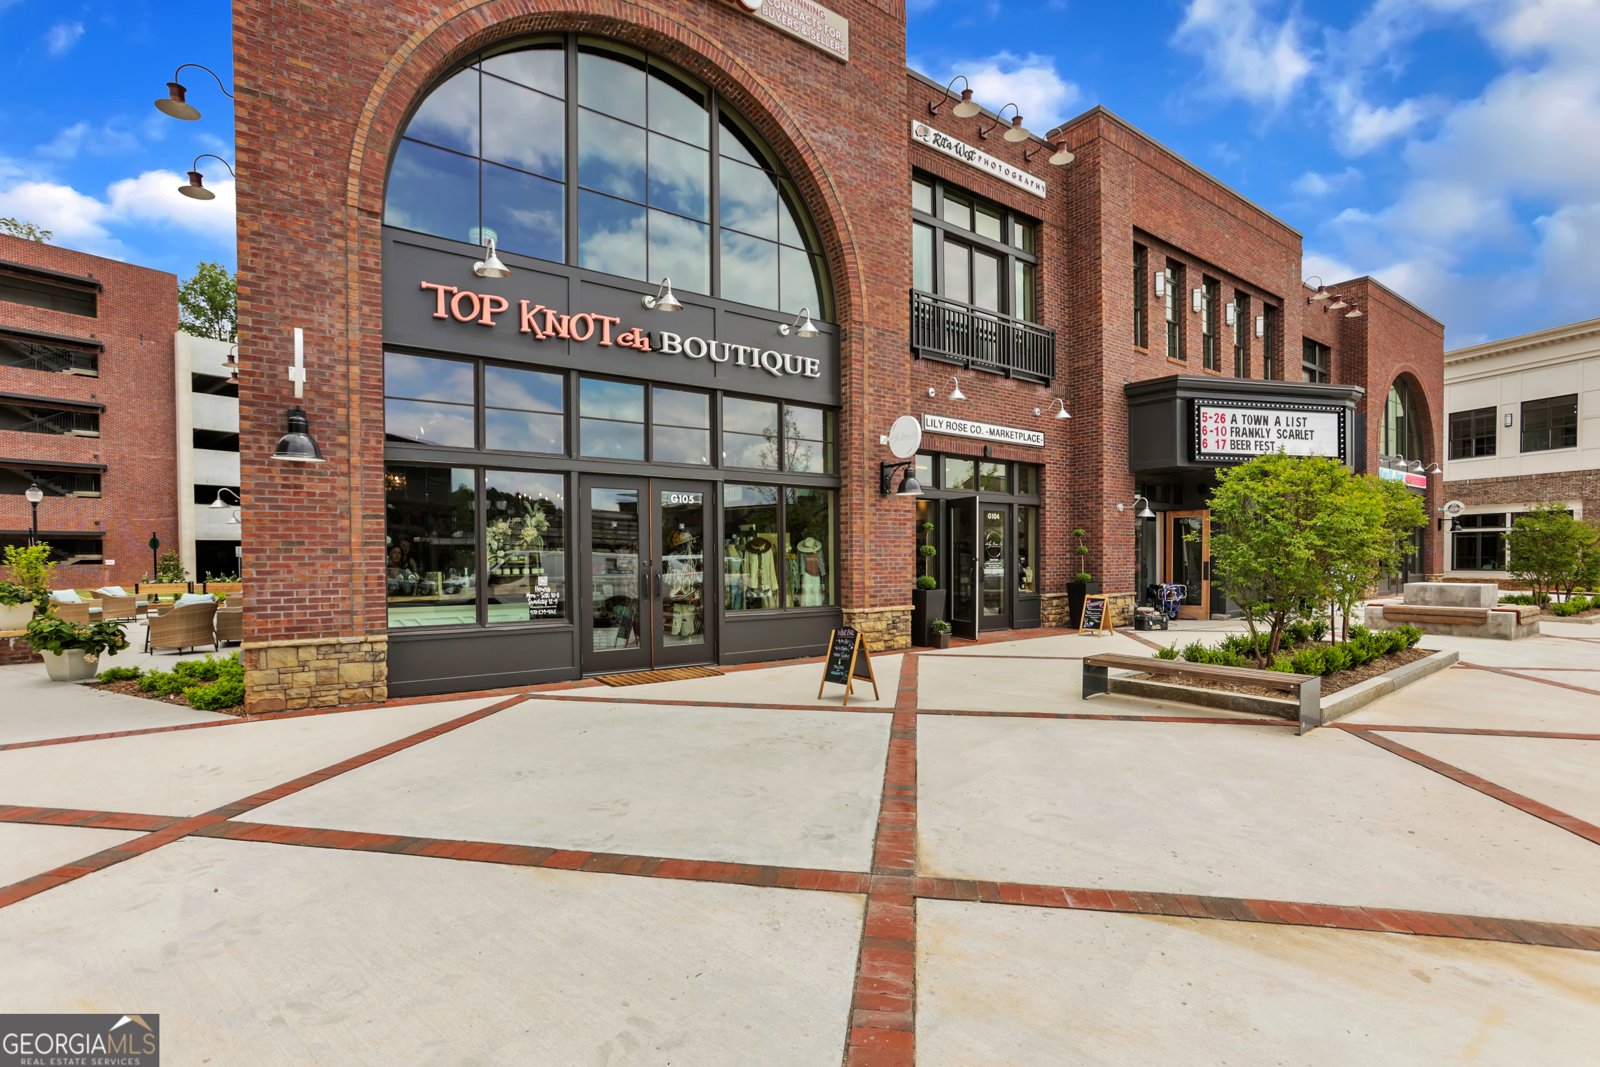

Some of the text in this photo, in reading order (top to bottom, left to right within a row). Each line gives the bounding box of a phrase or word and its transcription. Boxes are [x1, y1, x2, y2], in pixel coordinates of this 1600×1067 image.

[790, 0, 826, 20] INNING
[762, 5, 847, 56] BUYERS & SELLERS
[767, 0, 842, 42] CONTRACTS FOR
[933, 132, 1046, 193] Rita West PHOTOGRAPHY
[420, 280, 509, 327] TOP
[658, 330, 822, 379] BOUTIQUE
[926, 417, 944, 429] LILY
[946, 421, 968, 433] ROSE
[970, 423, 984, 435] CO.
[1202, 411, 1307, 428] 5-26 A TOWN A LIST
[1202, 425, 1315, 440] 6-10 FRANKLY SCARLET
[1230, 439, 1251, 450] BEER
[1254, 440, 1275, 451] FEST
[671, 494, 694, 504] G105
